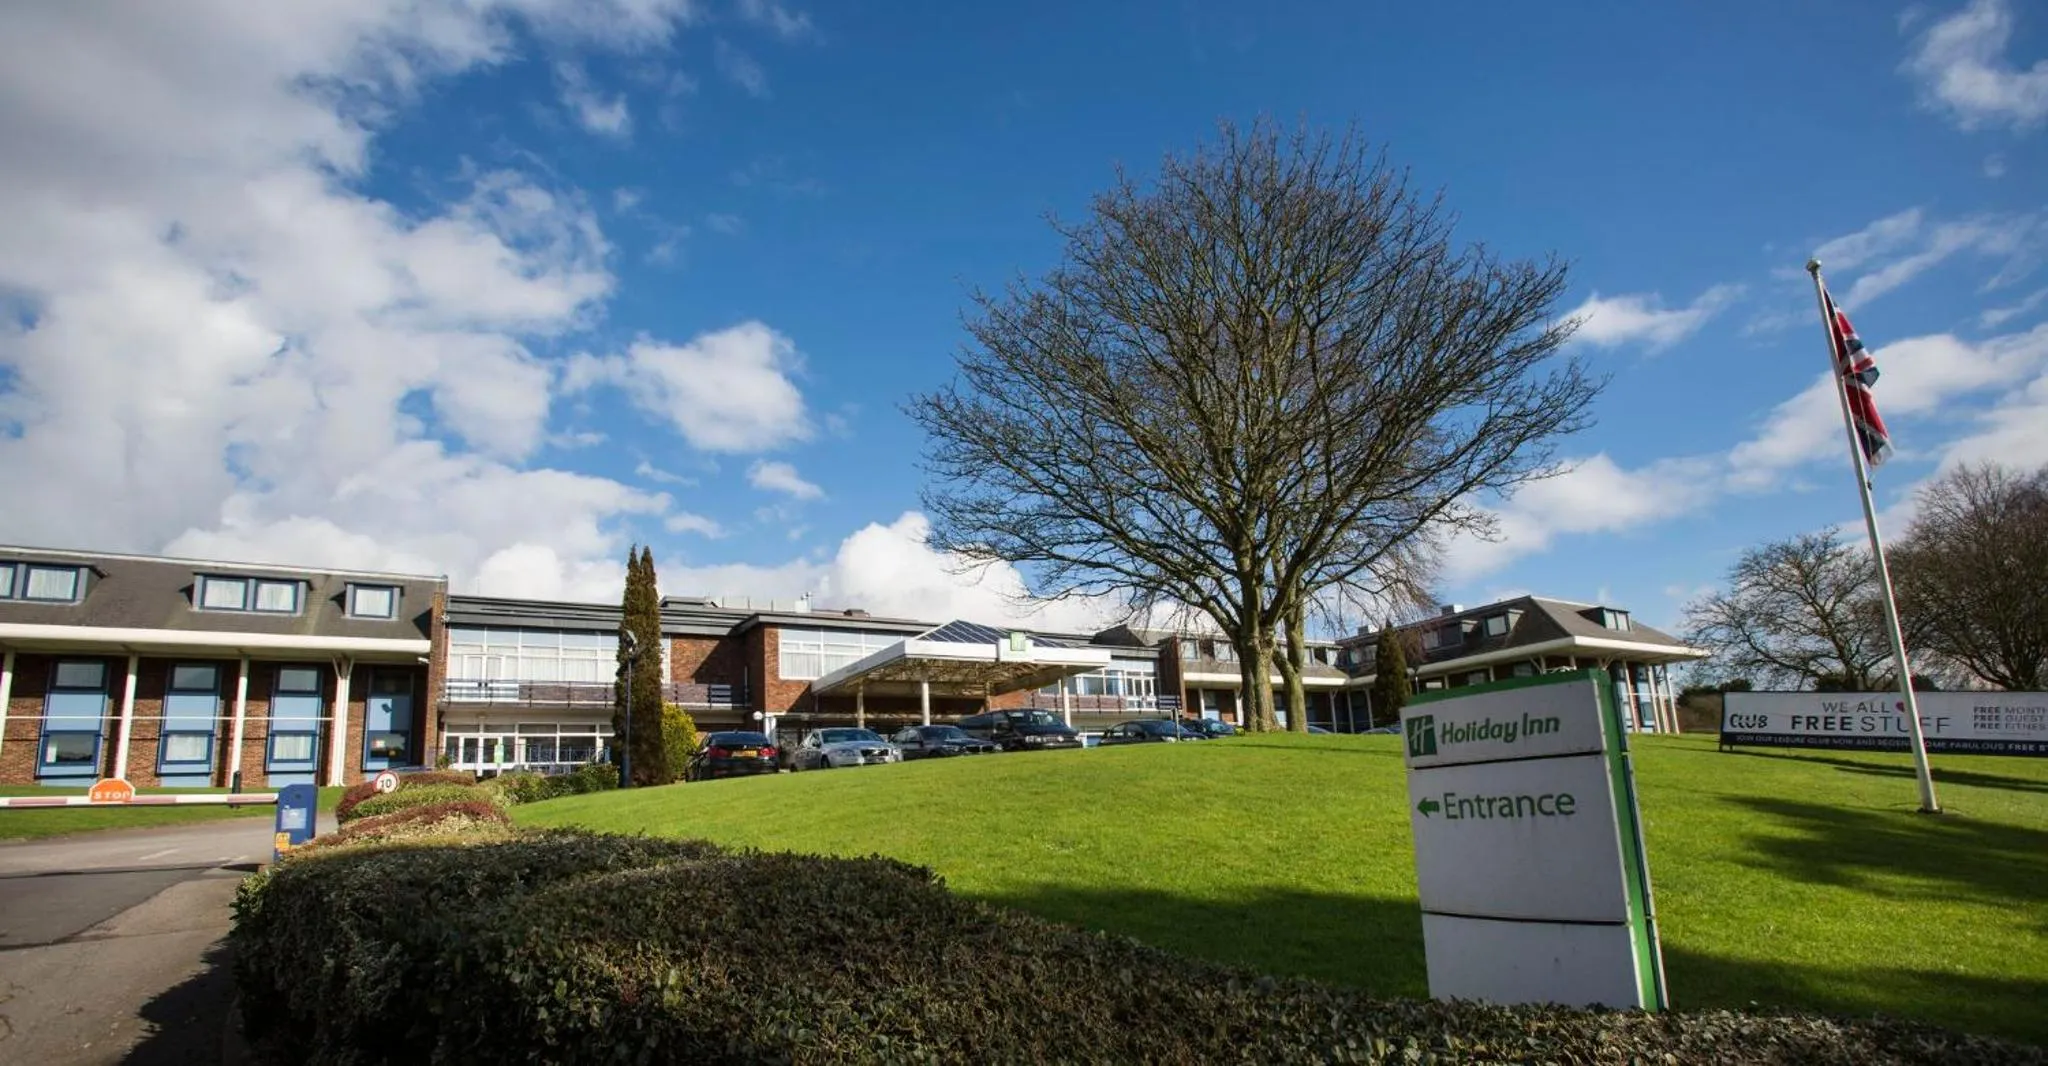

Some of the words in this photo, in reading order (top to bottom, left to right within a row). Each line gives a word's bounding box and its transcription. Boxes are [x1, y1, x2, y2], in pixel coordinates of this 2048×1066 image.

[1822, 702, 1849, 713] WE
[1856, 702, 1890, 713] ALL
[1973, 706, 2001, 714] FREE
[1973, 714, 2001, 722] FREE
[1791, 715, 1853, 731] FREE
[1973, 722, 2001, 730] FREE
[1441, 717, 1518, 744] Holiday
[1522, 712, 1560, 736] Inn
[2007, 742, 2035, 752] FREE
[380, 779, 392, 788] 10
[94, 791, 131, 800] STOP
[1443, 792, 1576, 820] Entrance
